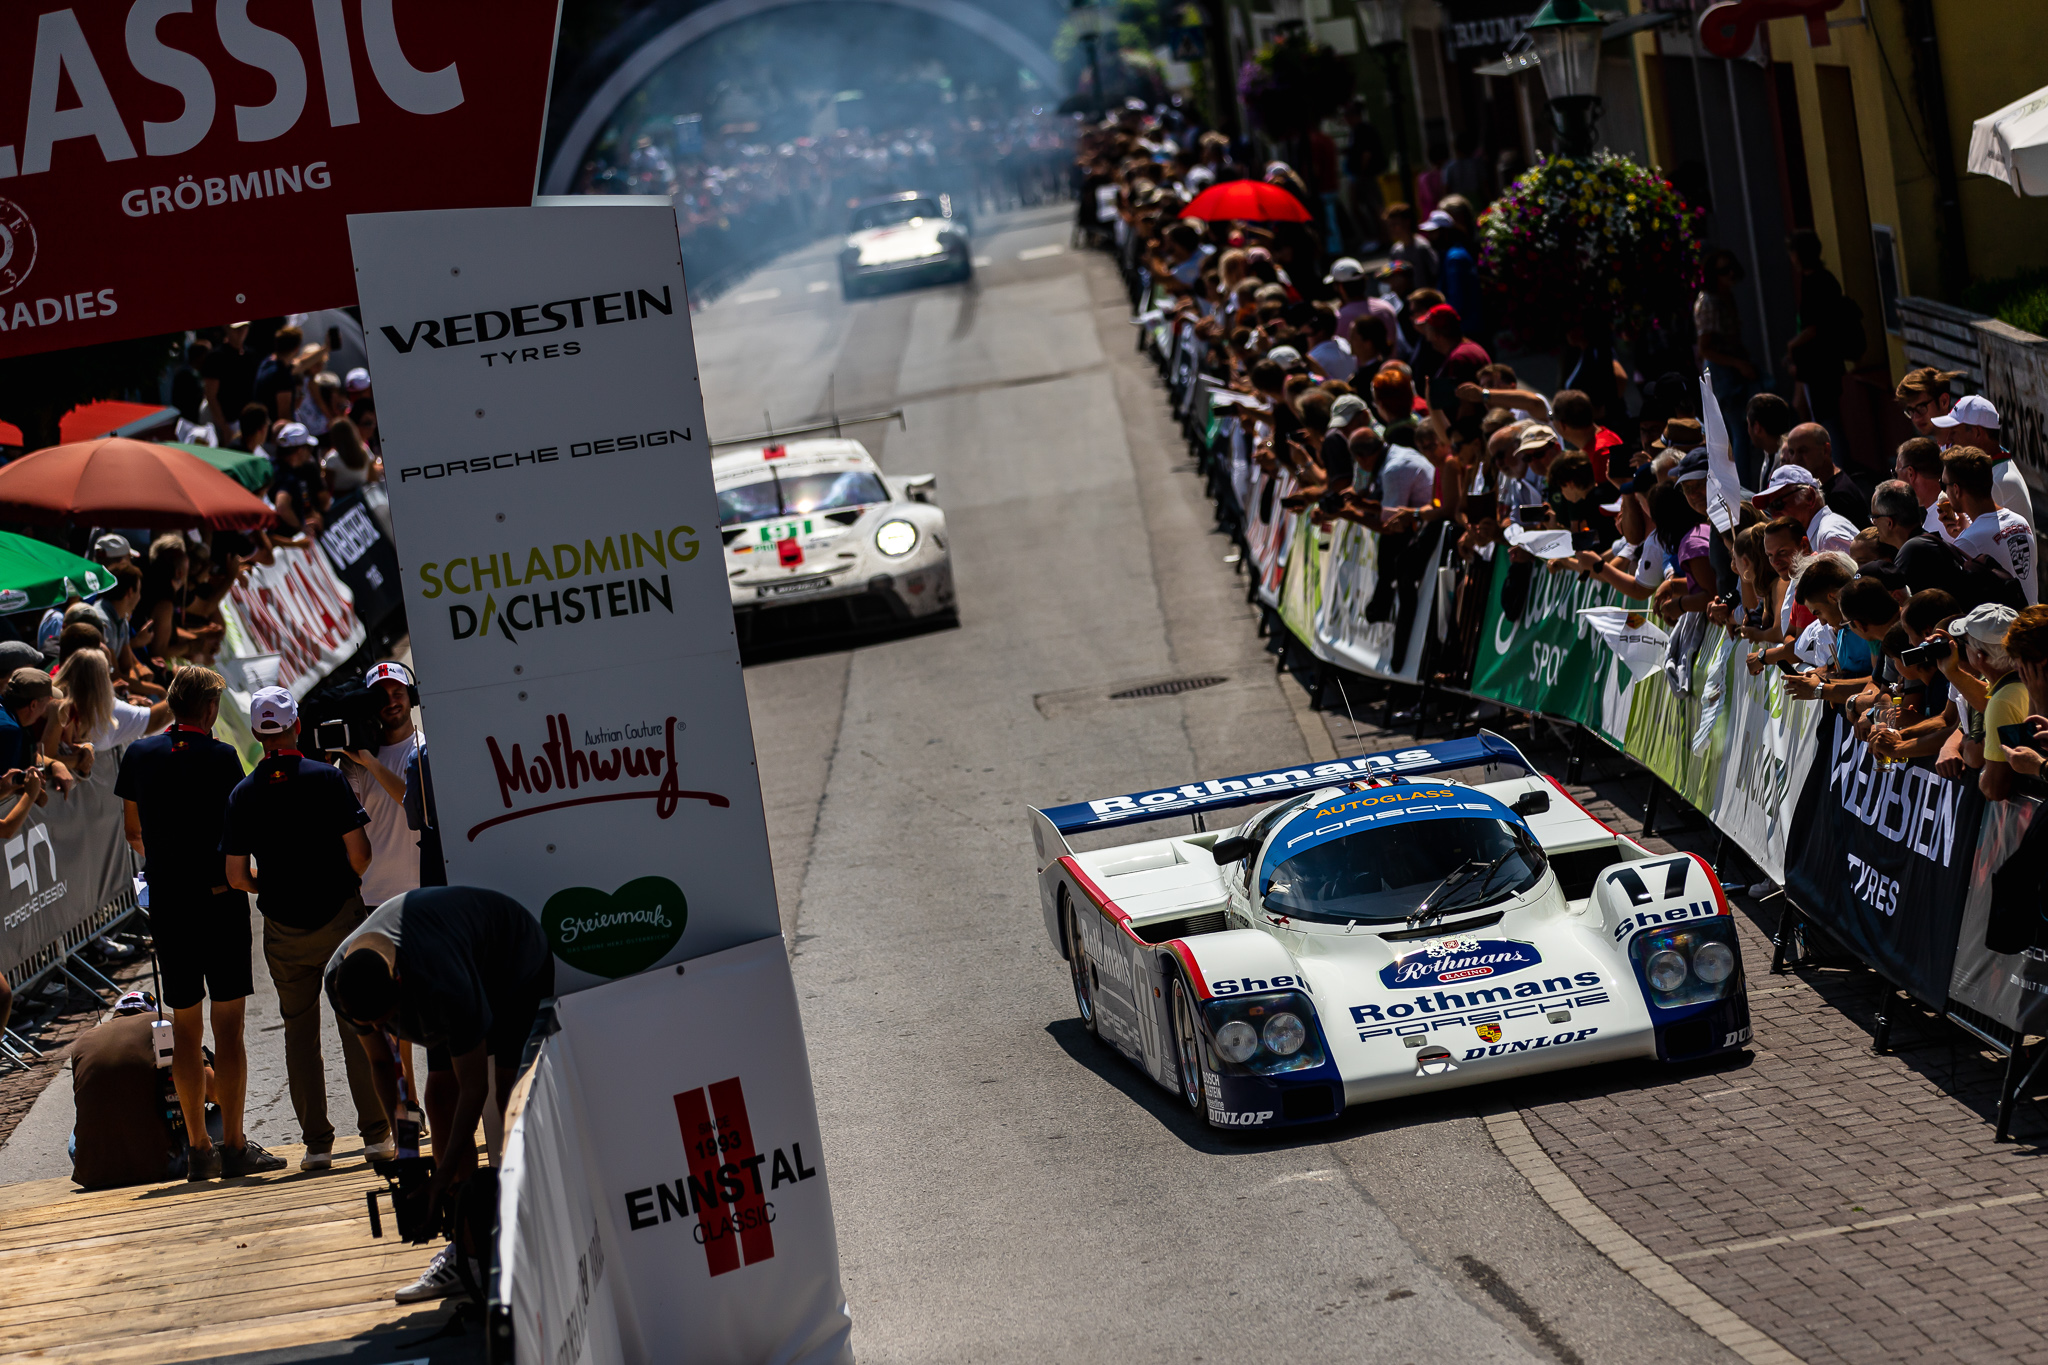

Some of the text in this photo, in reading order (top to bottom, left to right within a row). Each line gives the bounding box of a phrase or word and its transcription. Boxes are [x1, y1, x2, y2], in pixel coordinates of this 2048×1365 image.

[0, 0, 465, 179] ASSIC
[121, 161, 332, 217] GRÖBMING
[380, 285, 673, 354] VREDESTEIN
[480, 341, 582, 367] TYRES
[400, 427, 692, 483] PORSCHE DESIGN
[420, 525, 700, 599] SCHLADMING
[449, 574, 674, 645] DACHSTEIN
[585, 720, 662, 746] Austrian Couture
[485, 713, 678, 820] Mothwurf
[1087, 749, 1433, 814] Rothmans
[1287, 803, 1493, 849] PORSCHE
[1315, 790, 1455, 819] AUTOGLASS
[1606, 857, 1692, 906] 17
[1847, 852, 1900, 917] TYRES
[4, 897, 40, 932] PORSCHE
[560, 904, 672, 943] Steiermark
[1614, 900, 1714, 942] Shell
[1213, 973, 1314, 996] Shell
[1395, 948, 1531, 983] Rothmans
[1445, 967, 1488, 981] RACING
[1348, 972, 1601, 1024] Rothmans
[1359, 992, 1611, 1043] PORSCHE
[1462, 1028, 1598, 1062] DUNLOP
[698, 1115, 731, 1135] SINCE
[1209, 1111, 1274, 1126] DUNLOP
[696, 1130, 742, 1159] 1993
[625, 1142, 817, 1231] ENNSTAL
[693, 1201, 777, 1245] CLASSIC
